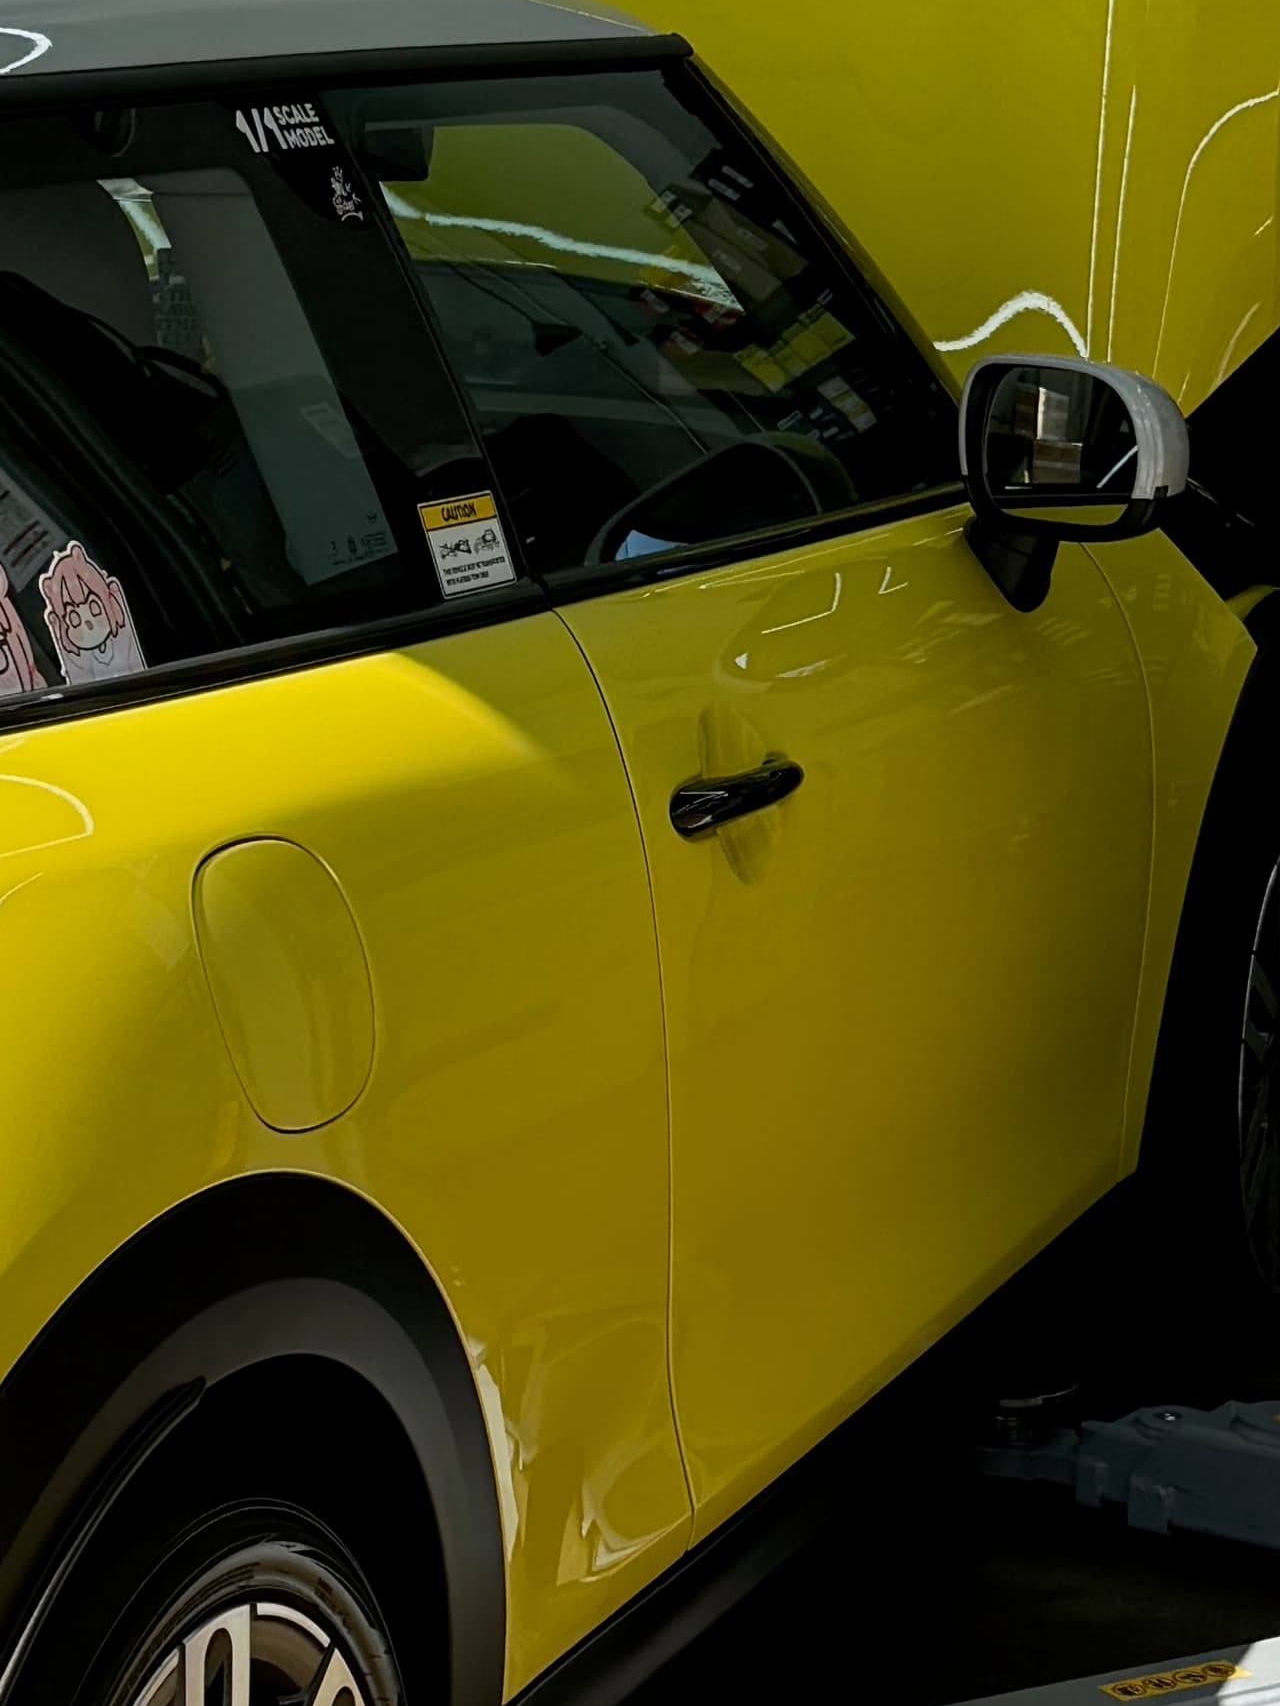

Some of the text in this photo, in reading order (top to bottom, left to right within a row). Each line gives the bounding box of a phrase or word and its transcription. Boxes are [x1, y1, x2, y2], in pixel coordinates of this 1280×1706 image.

[235, 103, 320, 154] 1/1 SCALE
[283, 125, 336, 150] MODEL
[441, 502, 477, 522] CAUTION
